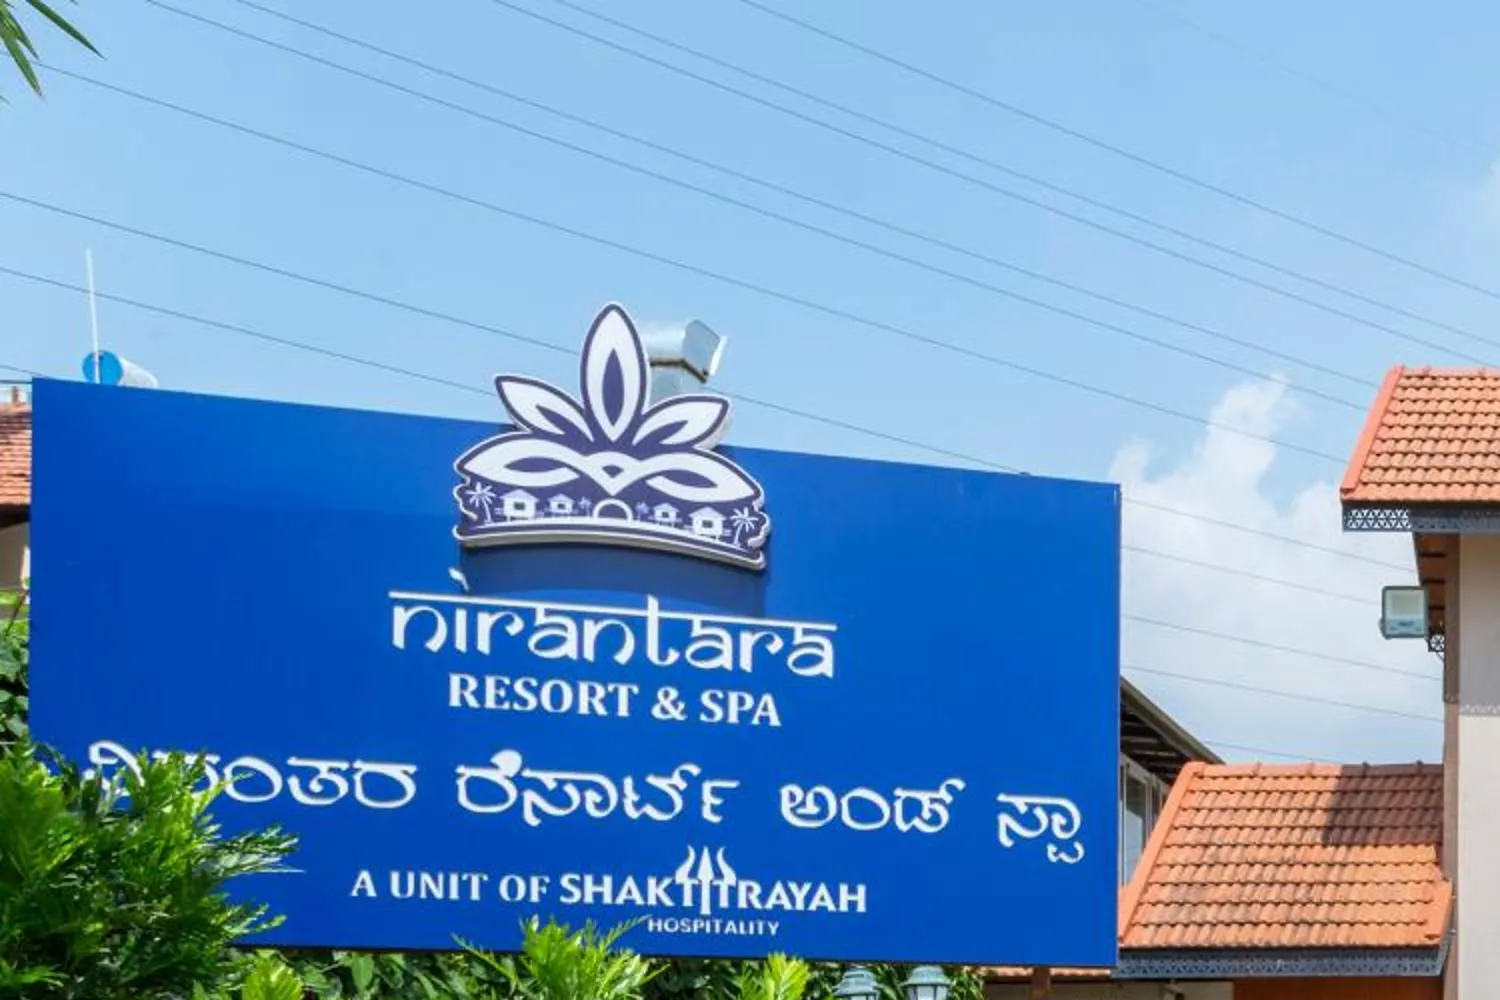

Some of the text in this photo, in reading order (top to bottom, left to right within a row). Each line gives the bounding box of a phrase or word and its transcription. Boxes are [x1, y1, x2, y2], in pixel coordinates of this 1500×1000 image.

[388, 567, 838, 678] nirantara
[449, 673, 781, 726] RESORT & SPA
[351, 870, 377, 897] A
[390, 870, 488, 901] UNIT
[499, 875, 550, 903] OF
[647, 918, 779, 937] HOSPITALITY
